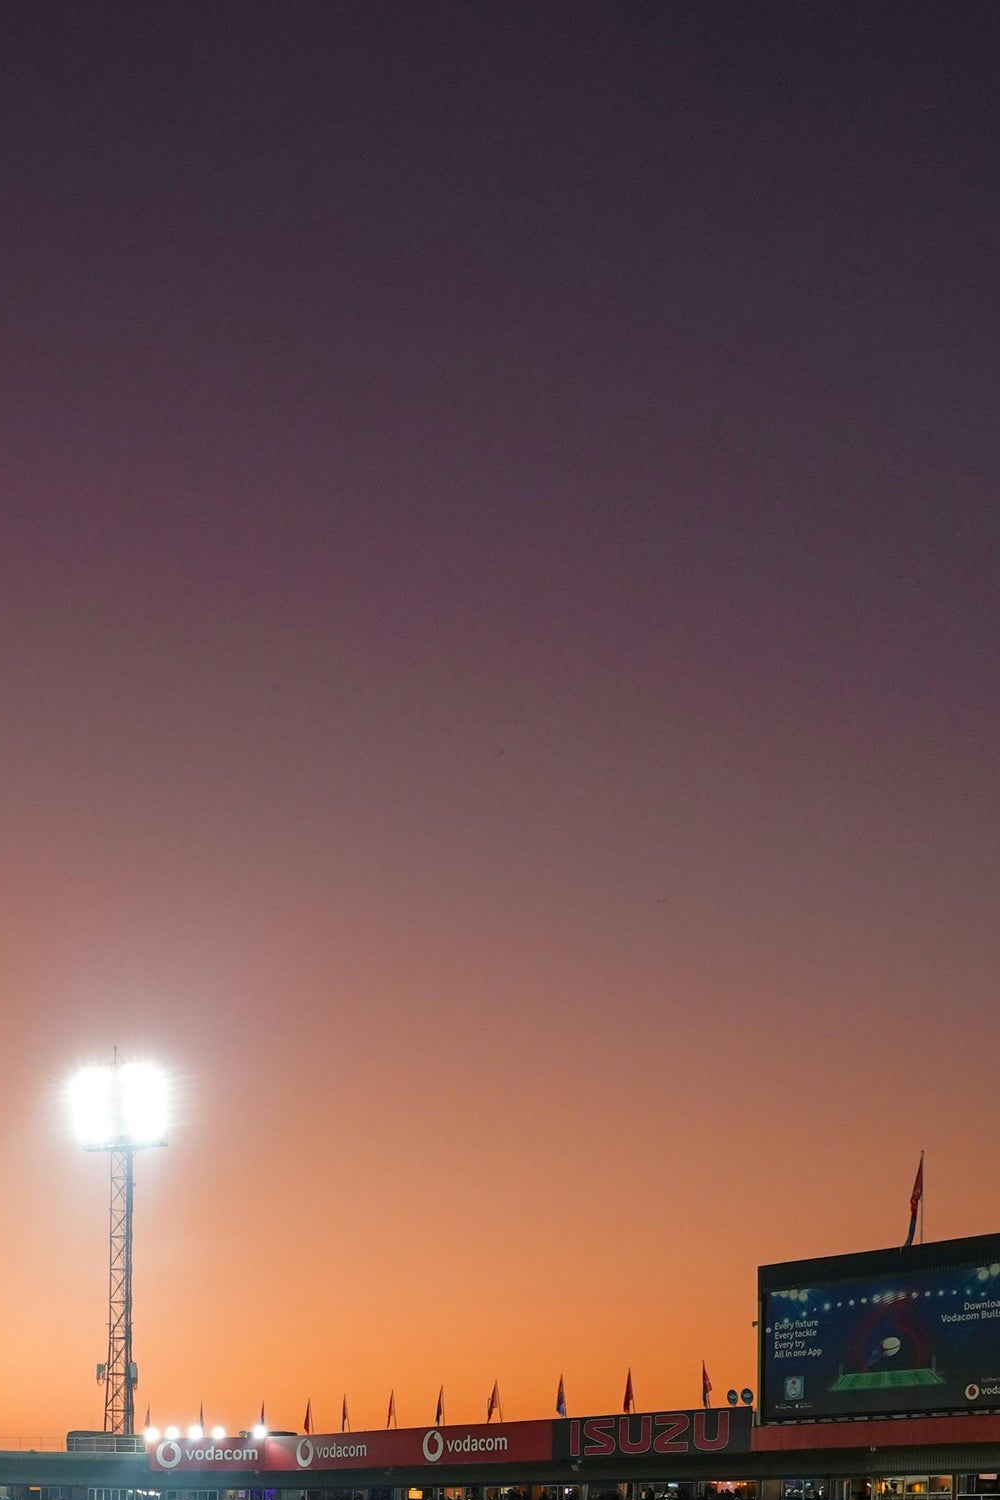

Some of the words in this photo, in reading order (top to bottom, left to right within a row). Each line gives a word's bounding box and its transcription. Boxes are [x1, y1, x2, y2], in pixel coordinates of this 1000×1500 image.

[941, 1313, 979, 1322] Vodacom
[774, 1322, 794, 1333] Every
[795, 1319, 819, 1328] fixture
[774, 1332, 794, 1342] Every
[795, 1329, 817, 1337] tackle
[774, 1341, 794, 1351] Every
[796, 1340, 805, 1350] try
[774, 1350, 784, 1358] All
[808, 1347, 822, 1358] App
[570, 1411, 729, 1456] ISUZU
[315, 1441, 366, 1458] vodacom
[447, 1435, 507, 1452] vodacom
[185, 1445, 258, 1460] vodacom
